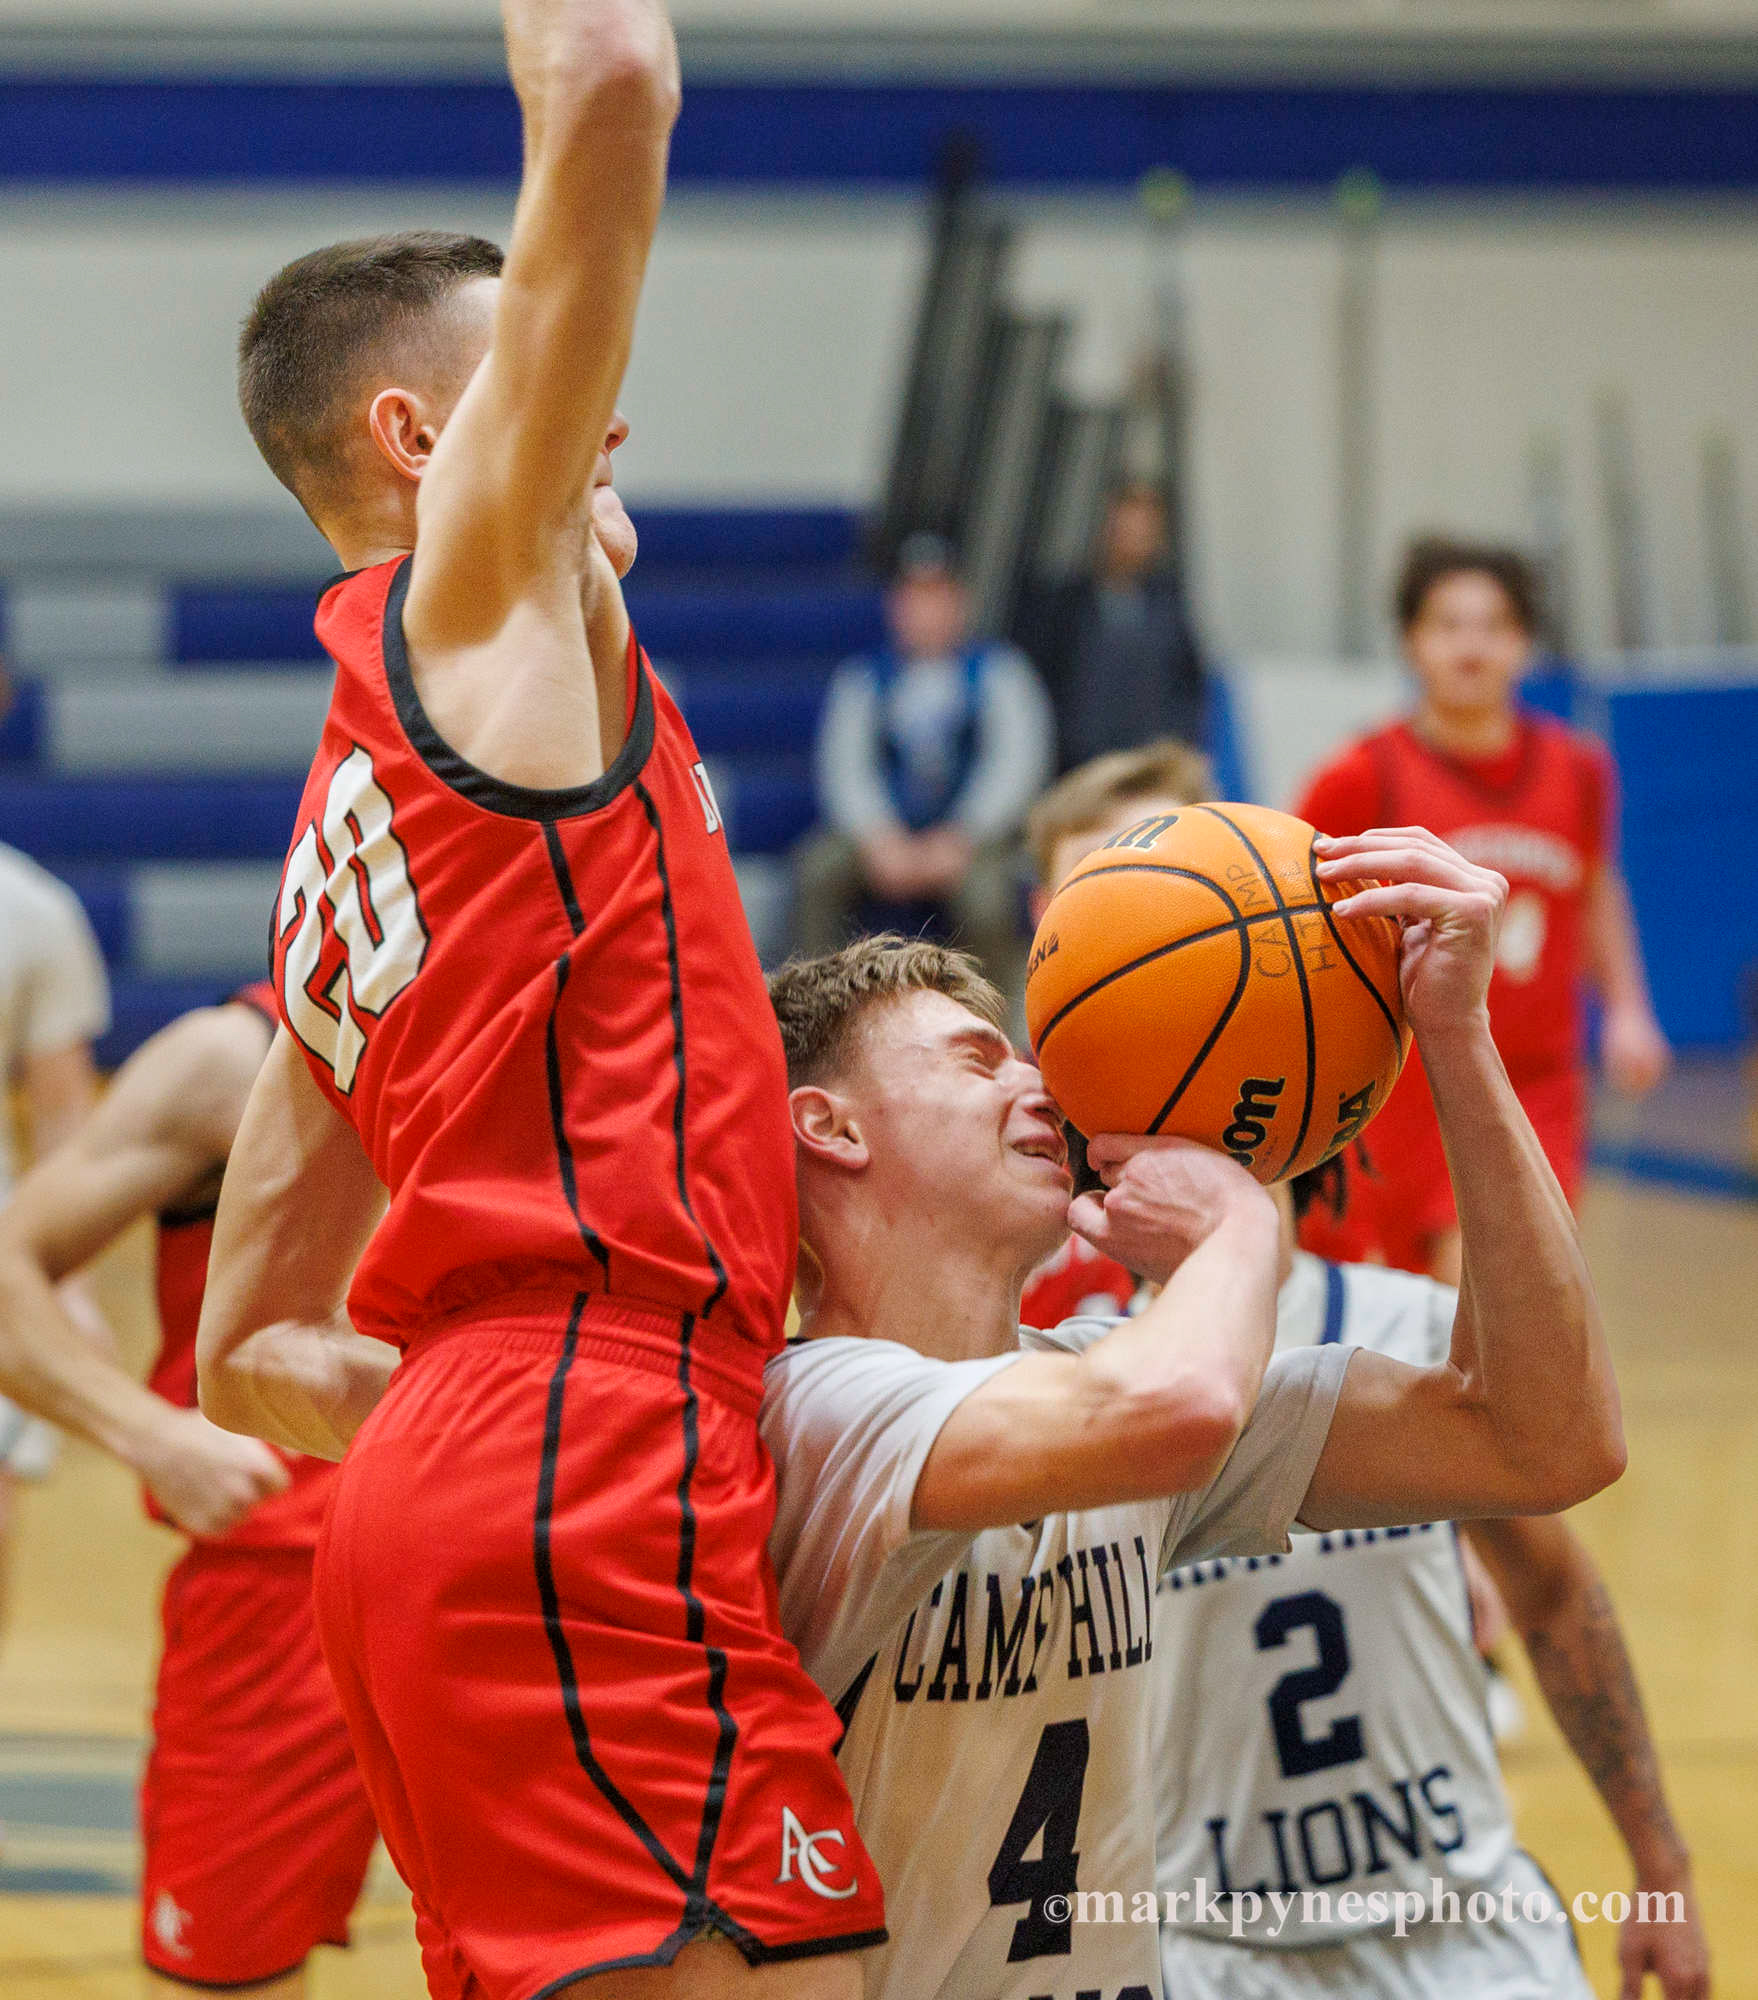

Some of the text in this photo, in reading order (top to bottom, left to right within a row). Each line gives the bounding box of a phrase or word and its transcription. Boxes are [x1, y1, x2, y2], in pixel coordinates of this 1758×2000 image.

[279, 741, 431, 1096] 20
[1226, 863, 1291, 978] CAMP
[1254, 1590, 1367, 1779] 2
[988, 1717, 1090, 1964] 4
[1205, 1766, 1468, 1904] LIONS
